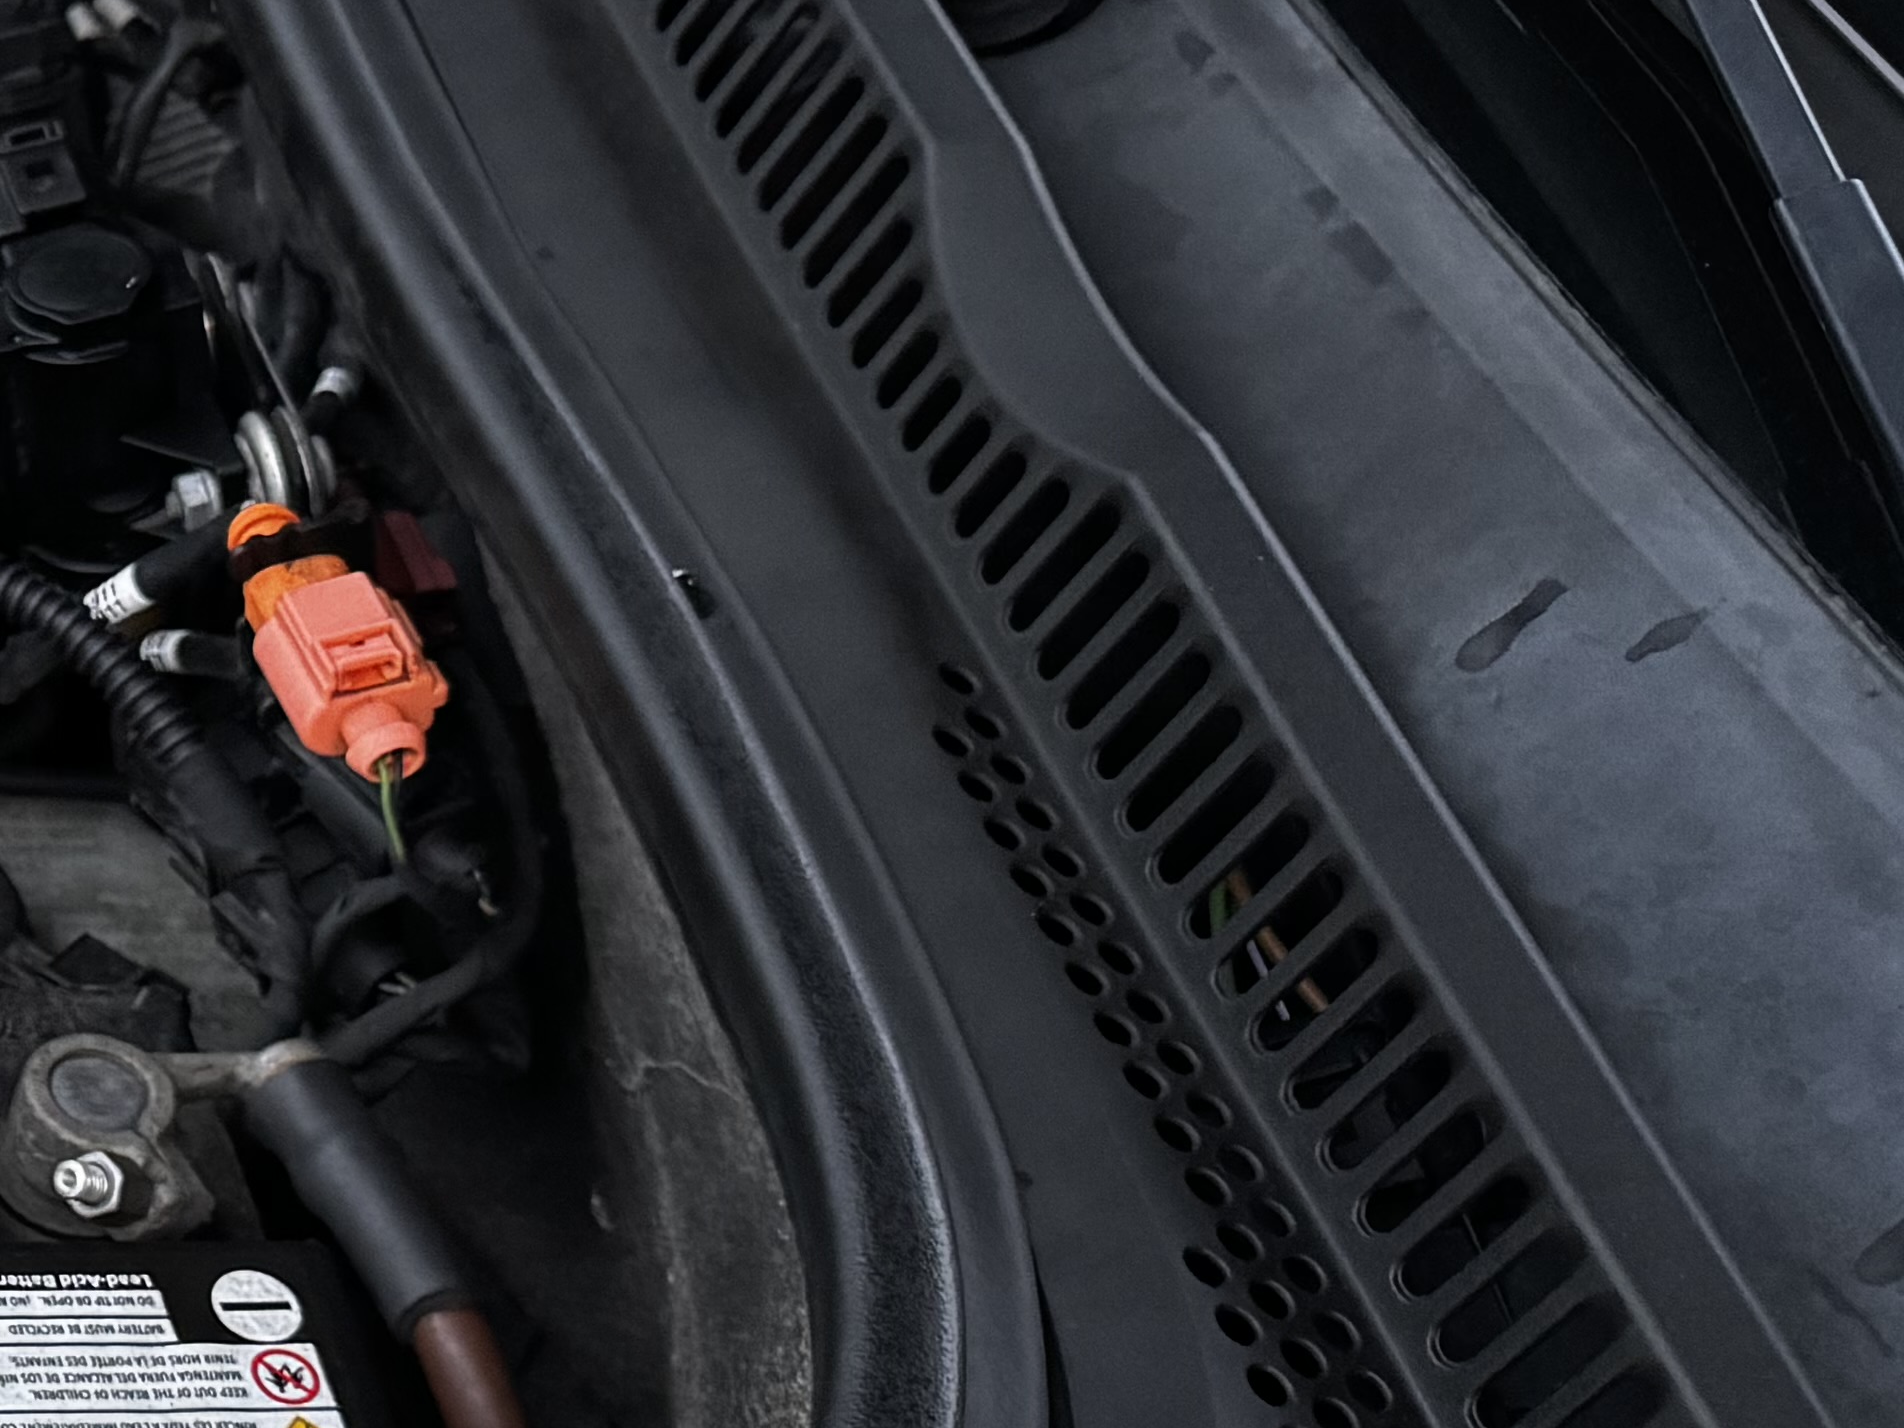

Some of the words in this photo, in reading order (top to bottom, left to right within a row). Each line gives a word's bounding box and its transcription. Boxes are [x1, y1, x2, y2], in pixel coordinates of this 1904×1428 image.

[57, 1273, 153, 1287] Lead-Acid
[92, 1388, 109, 1399] OF
[109, 1388, 150, 1398] REACH
[150, 1387, 175, 1398] THE
[175, 1387, 193, 1398] OF
[193, 1387, 218, 1398] OUT
[218, 1387, 248, 1397] KEEP
